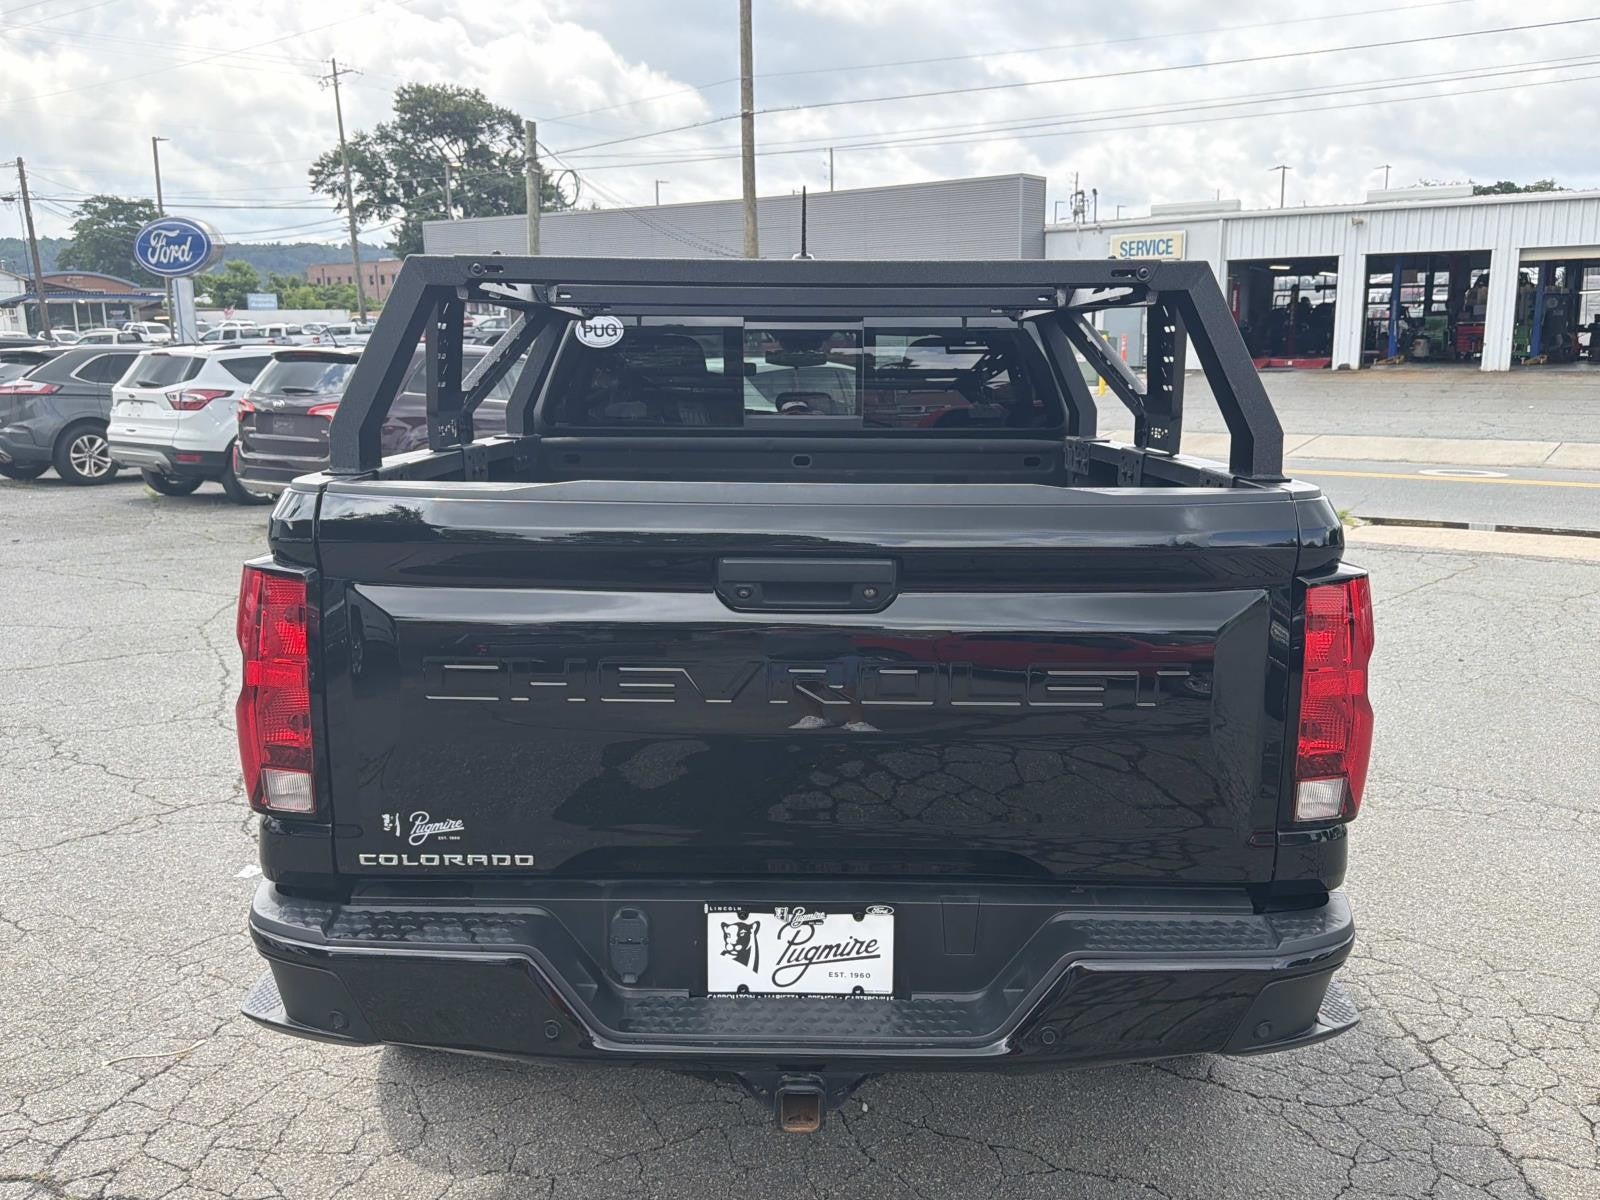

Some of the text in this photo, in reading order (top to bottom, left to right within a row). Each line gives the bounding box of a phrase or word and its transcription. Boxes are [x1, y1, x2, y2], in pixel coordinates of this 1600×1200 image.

[147, 229, 193, 265] Ford
[1119, 238, 1174, 257] SERVICE
[583, 323, 618, 338] PUG
[422, 656, 1192, 706] CHEVROLET
[408, 811, 464, 846] Pugmire
[358, 853, 534, 866] COLORADO
[772, 923, 881, 988] Pugmire
